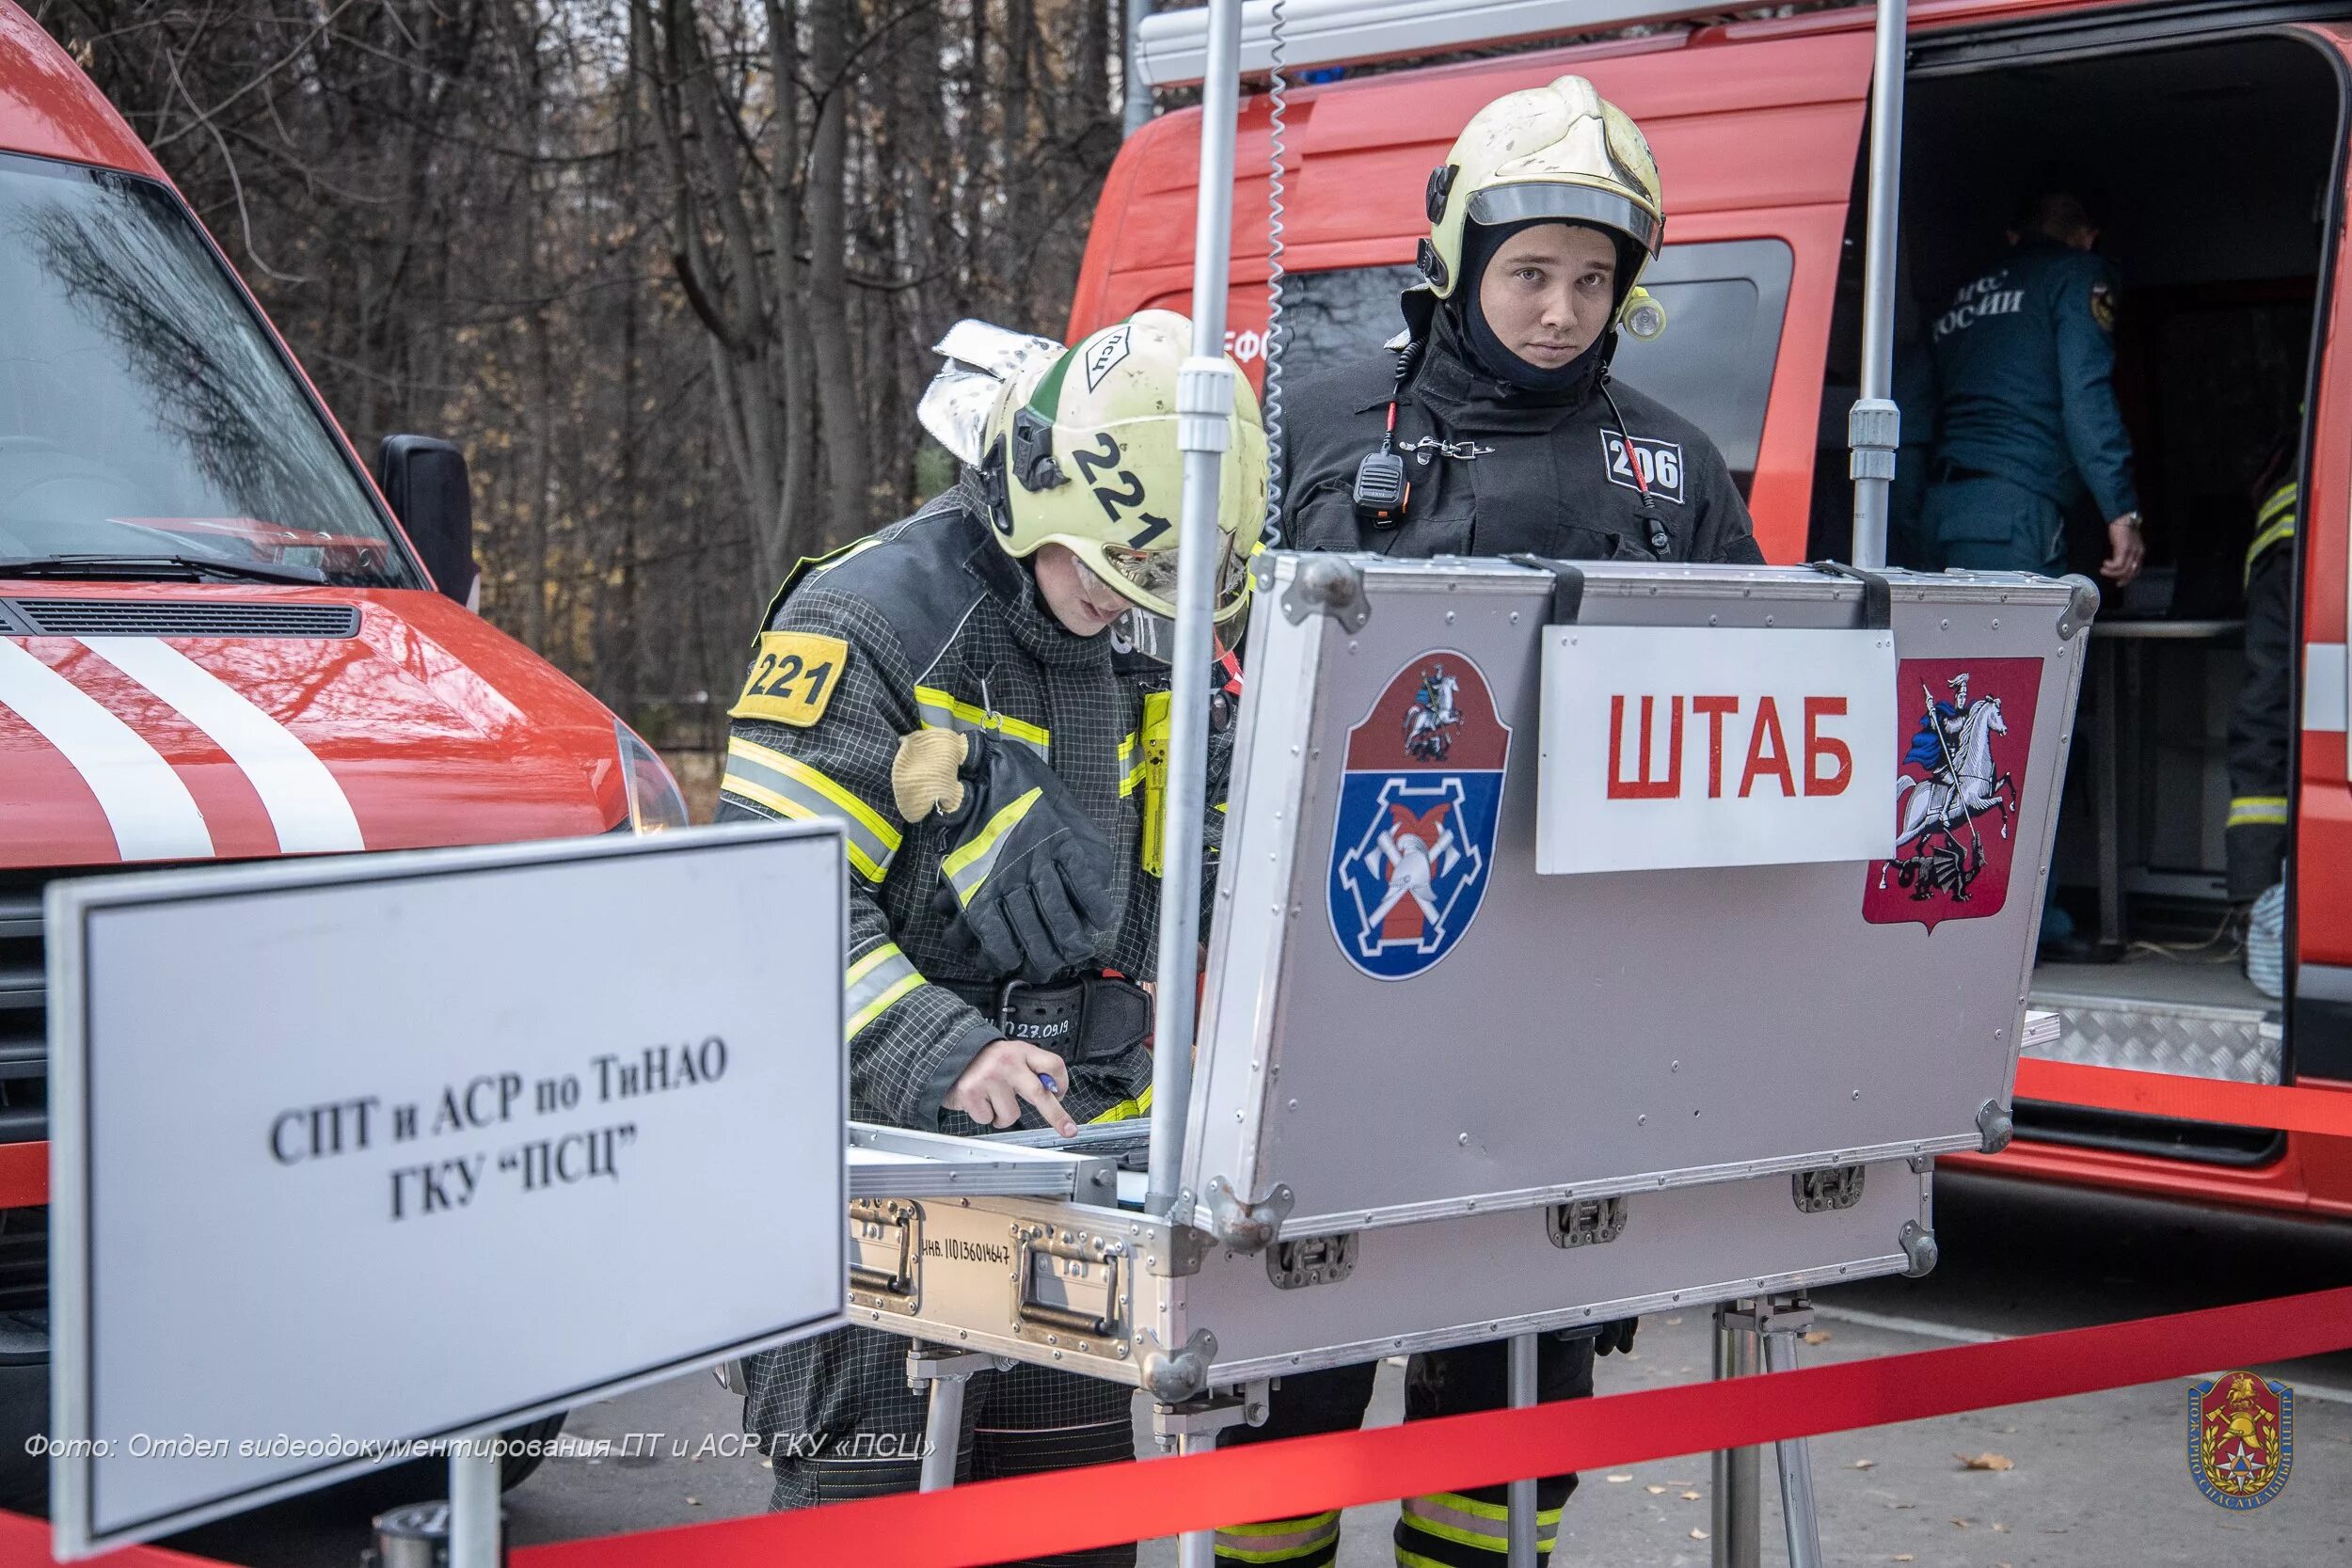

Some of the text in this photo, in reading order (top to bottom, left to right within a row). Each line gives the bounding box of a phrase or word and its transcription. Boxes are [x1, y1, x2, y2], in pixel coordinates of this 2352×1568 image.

[1073, 432, 1172, 551] 221
[1610, 439, 1678, 489] 206
[746, 653, 834, 705] 221
[1607, 695, 1852, 800] ШТАБ
[1016, 1020, 1069, 1038] 27.09.19
[268, 1034, 728, 1166] СПТ и АСР по ТиНАО
[389, 1152, 487, 1222] ГКУ
